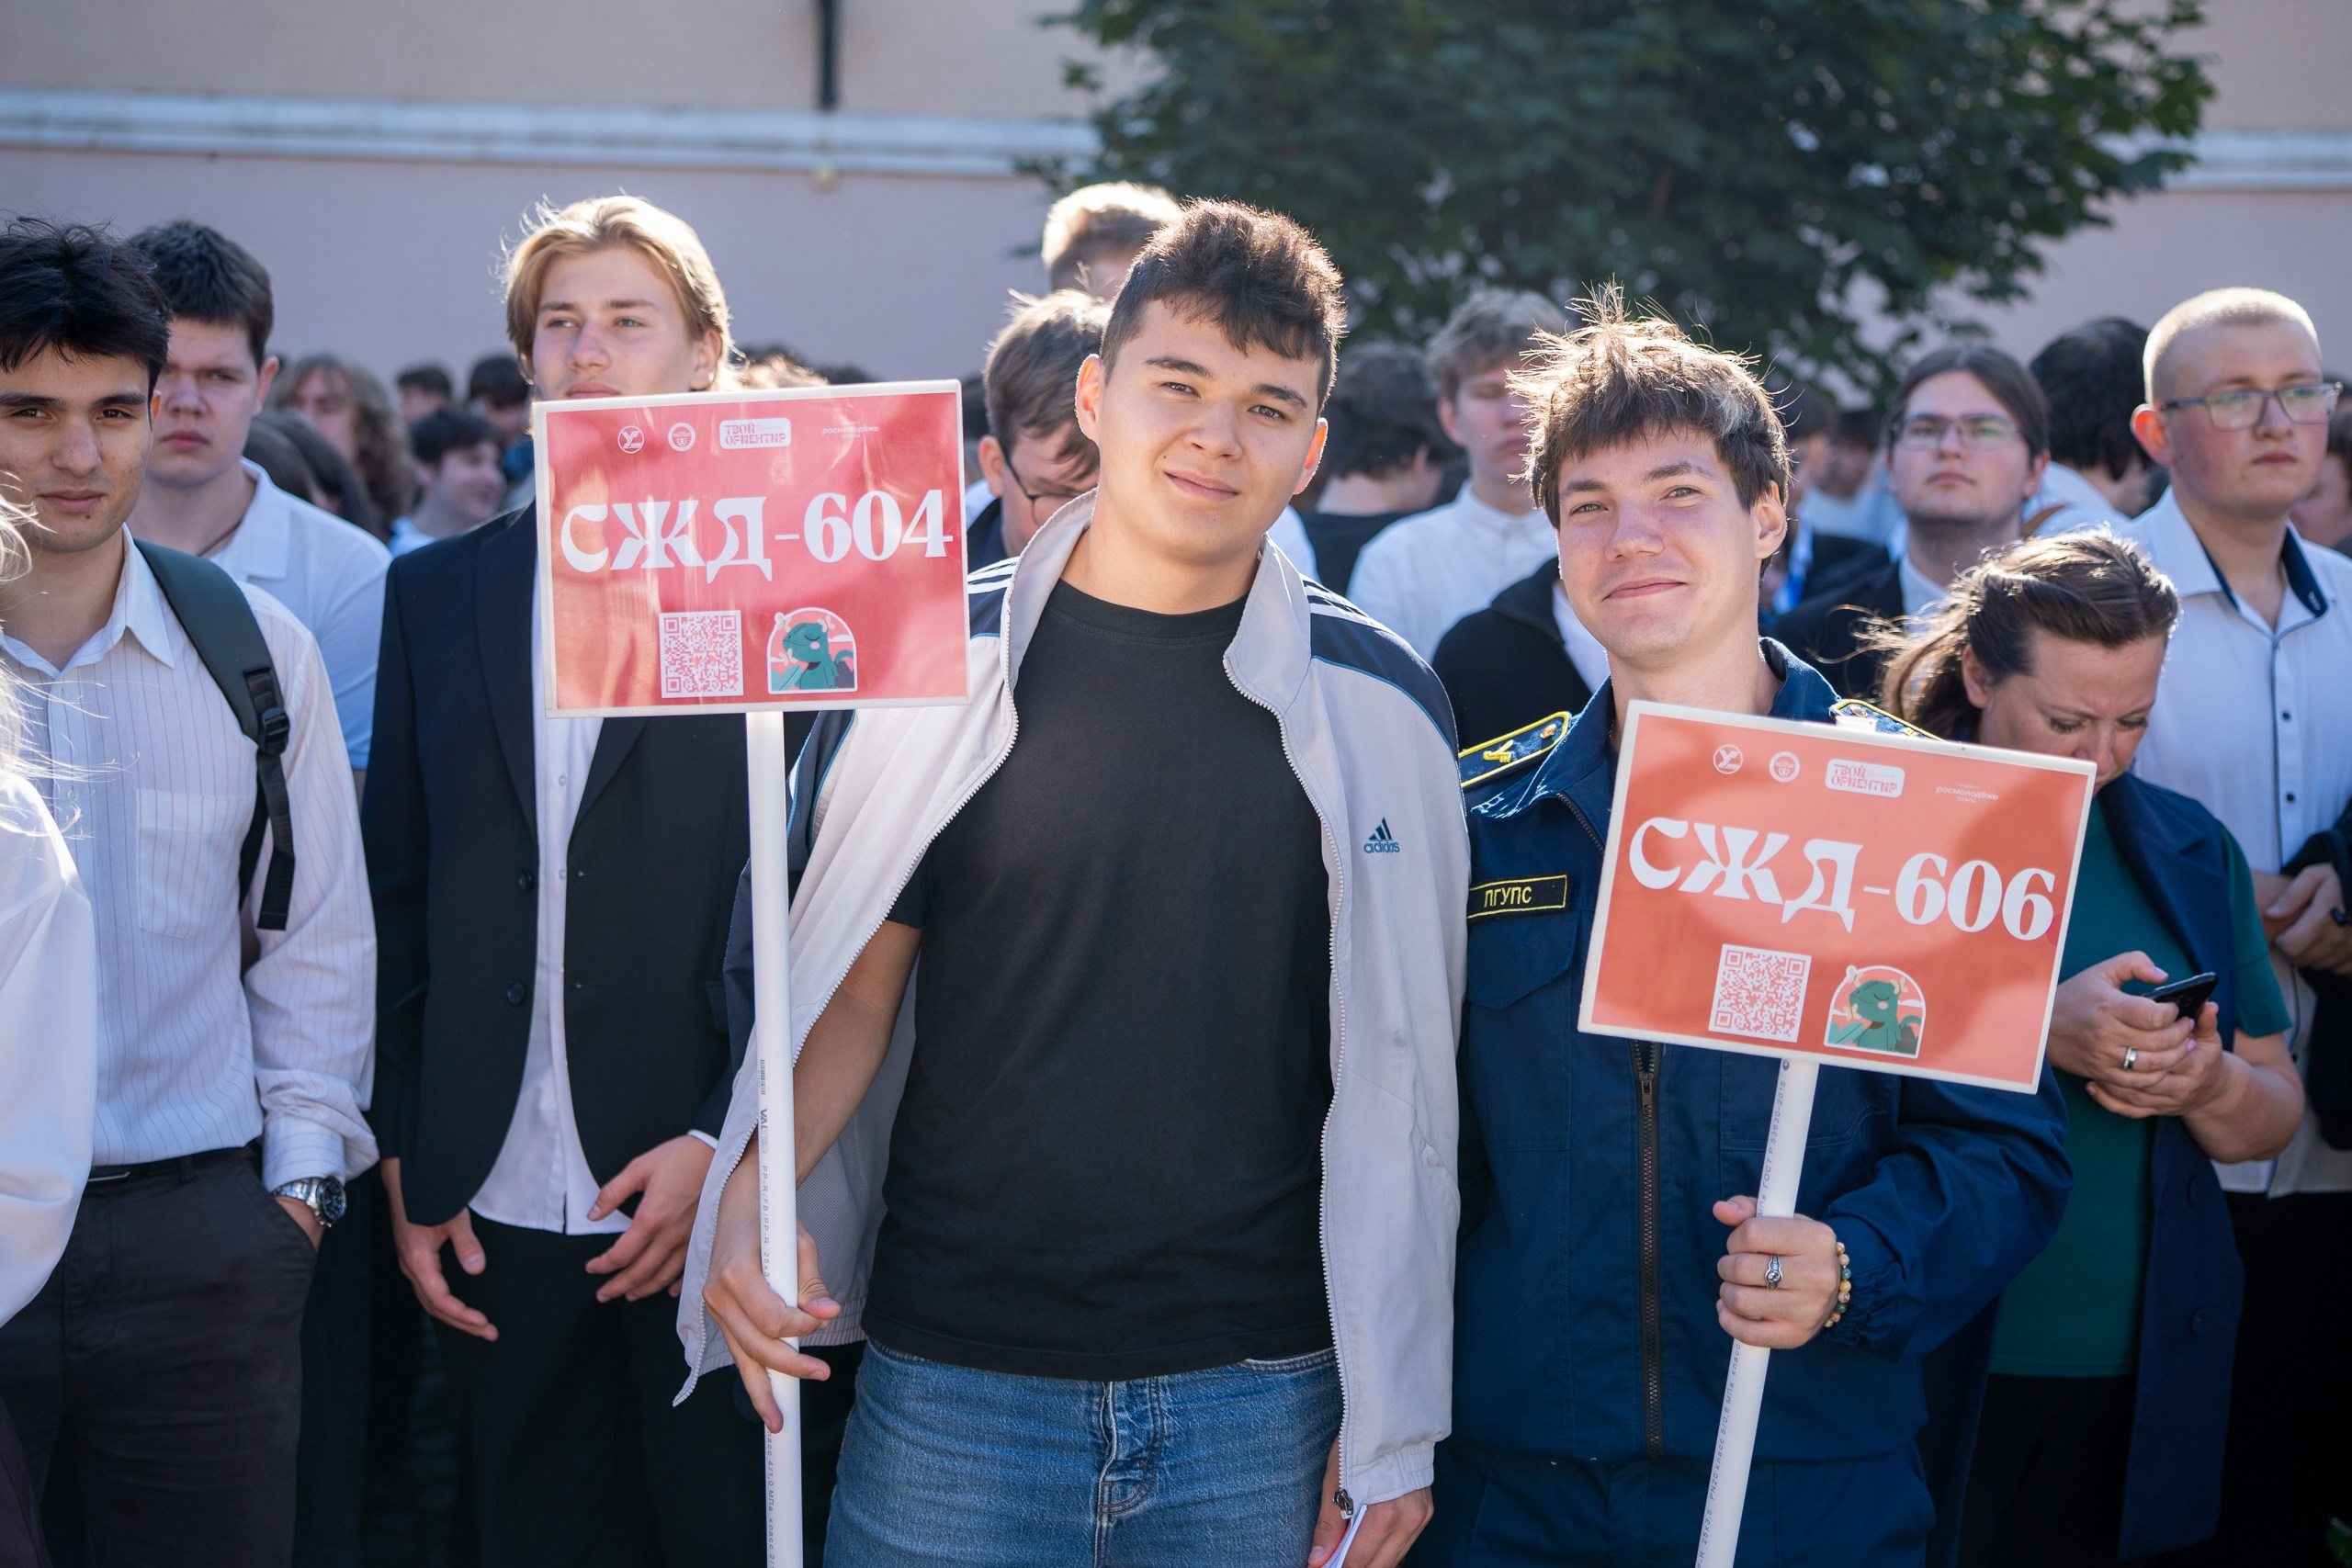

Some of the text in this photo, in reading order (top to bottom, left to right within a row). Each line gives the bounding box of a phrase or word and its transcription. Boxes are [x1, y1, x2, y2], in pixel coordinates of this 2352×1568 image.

[725, 423, 755, 434] ТВОЙ
[725, 434, 786, 446] ОРИЕНТИР
[560, 488, 954, 584] СЖД-604
[1834, 764, 1866, 778] ТВОЙ
[1831, 775, 1897, 793] ОРИЕНТИР
[1363, 840, 1400, 853] adidas
[1628, 817, 2056, 941] СЖД-606
[1484, 886, 1532, 908] ПГУПС
[761, 1109, 769, 1154] VALTEC
[1763, 1157, 1772, 1189] ГОСТ
